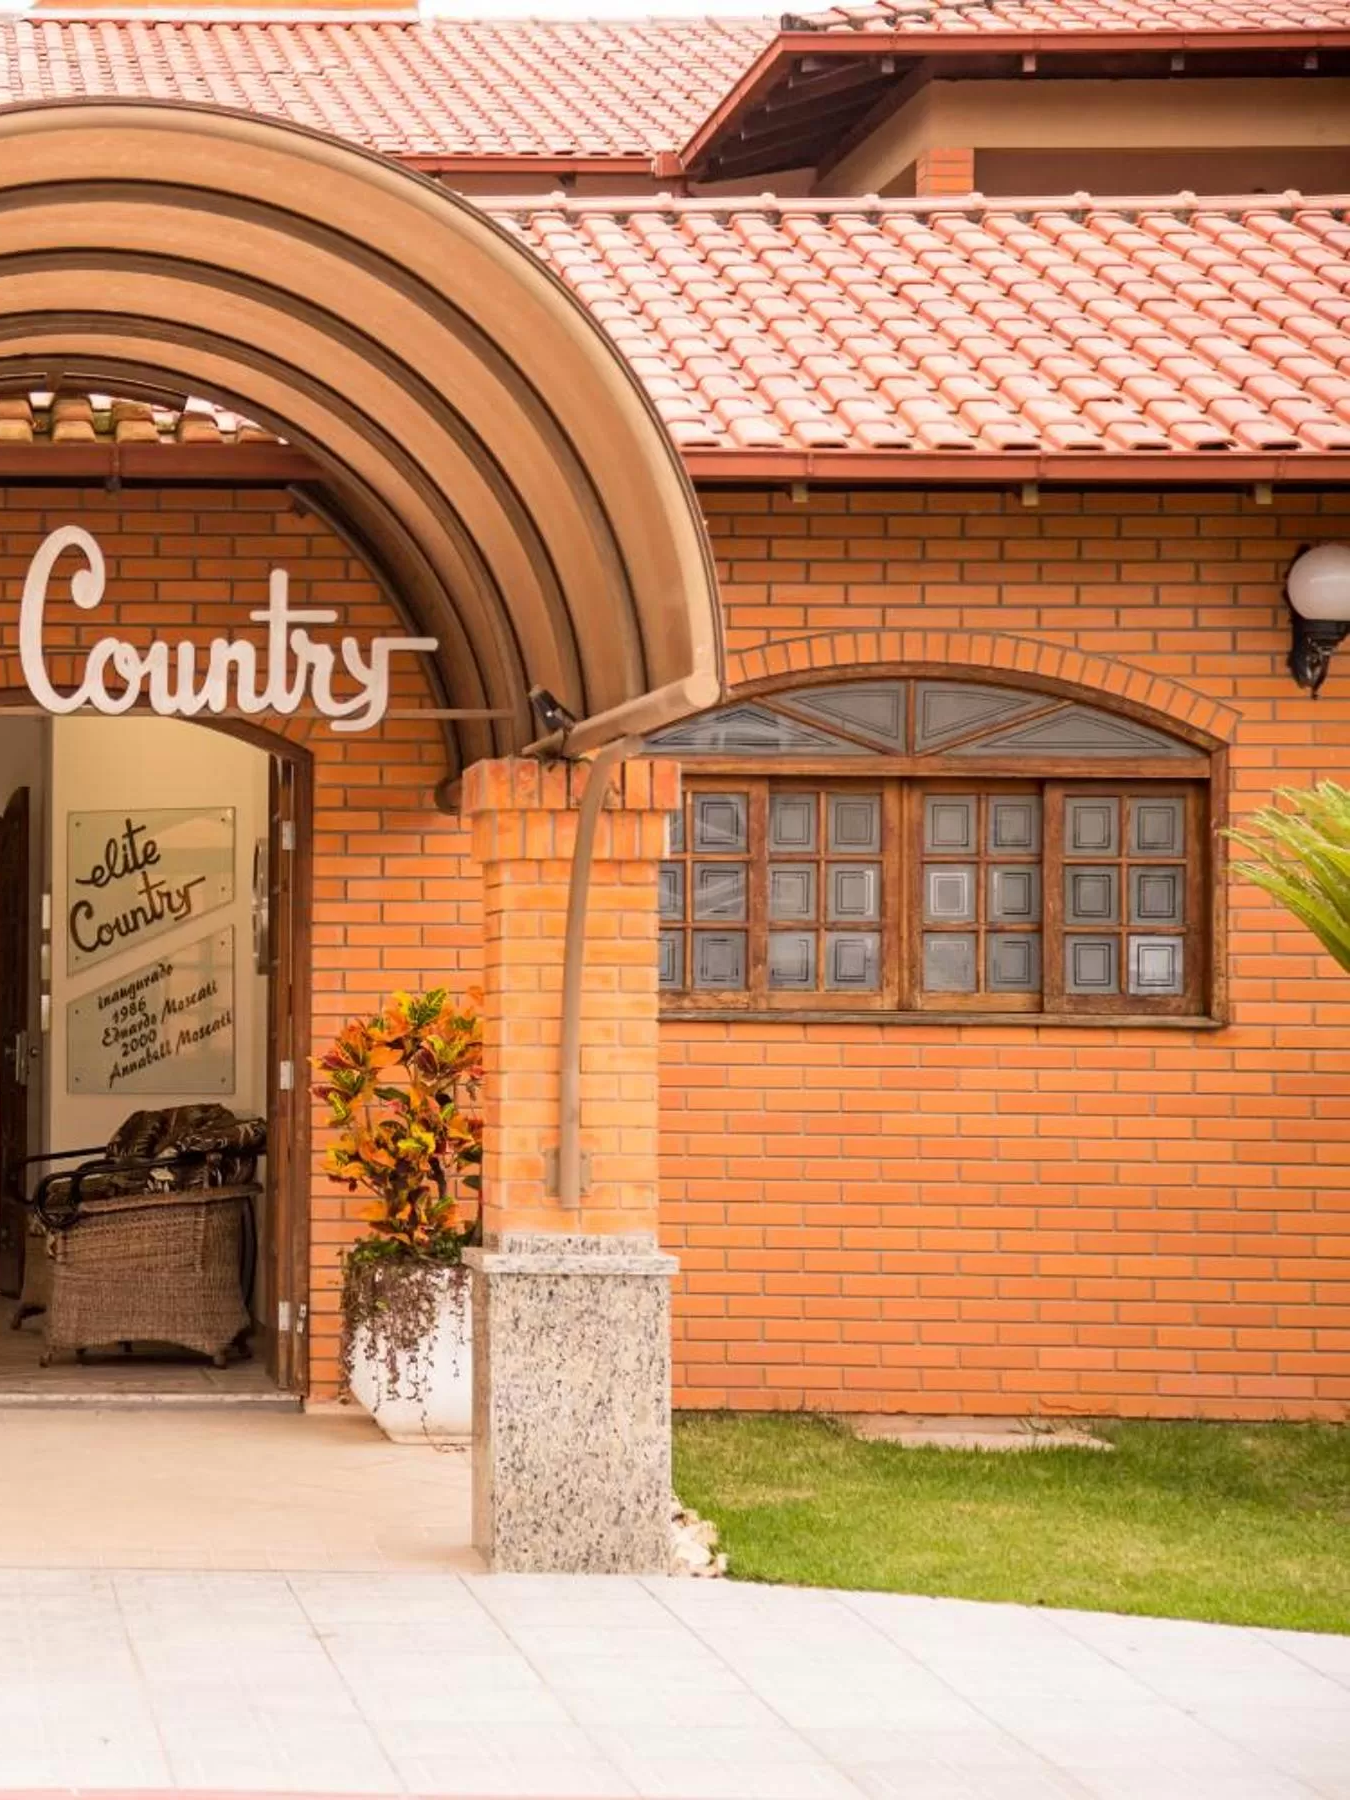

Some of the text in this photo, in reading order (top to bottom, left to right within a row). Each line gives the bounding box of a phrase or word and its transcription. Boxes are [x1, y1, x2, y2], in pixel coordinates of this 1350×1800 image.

[19, 524, 439, 733] Country
[75, 817, 161, 888] elite
[70, 871, 206, 953] Country
[102, 1012, 158, 1047] Eduardo
[111, 997, 147, 1024] 1986
[121, 1029, 158, 1058] 2000
